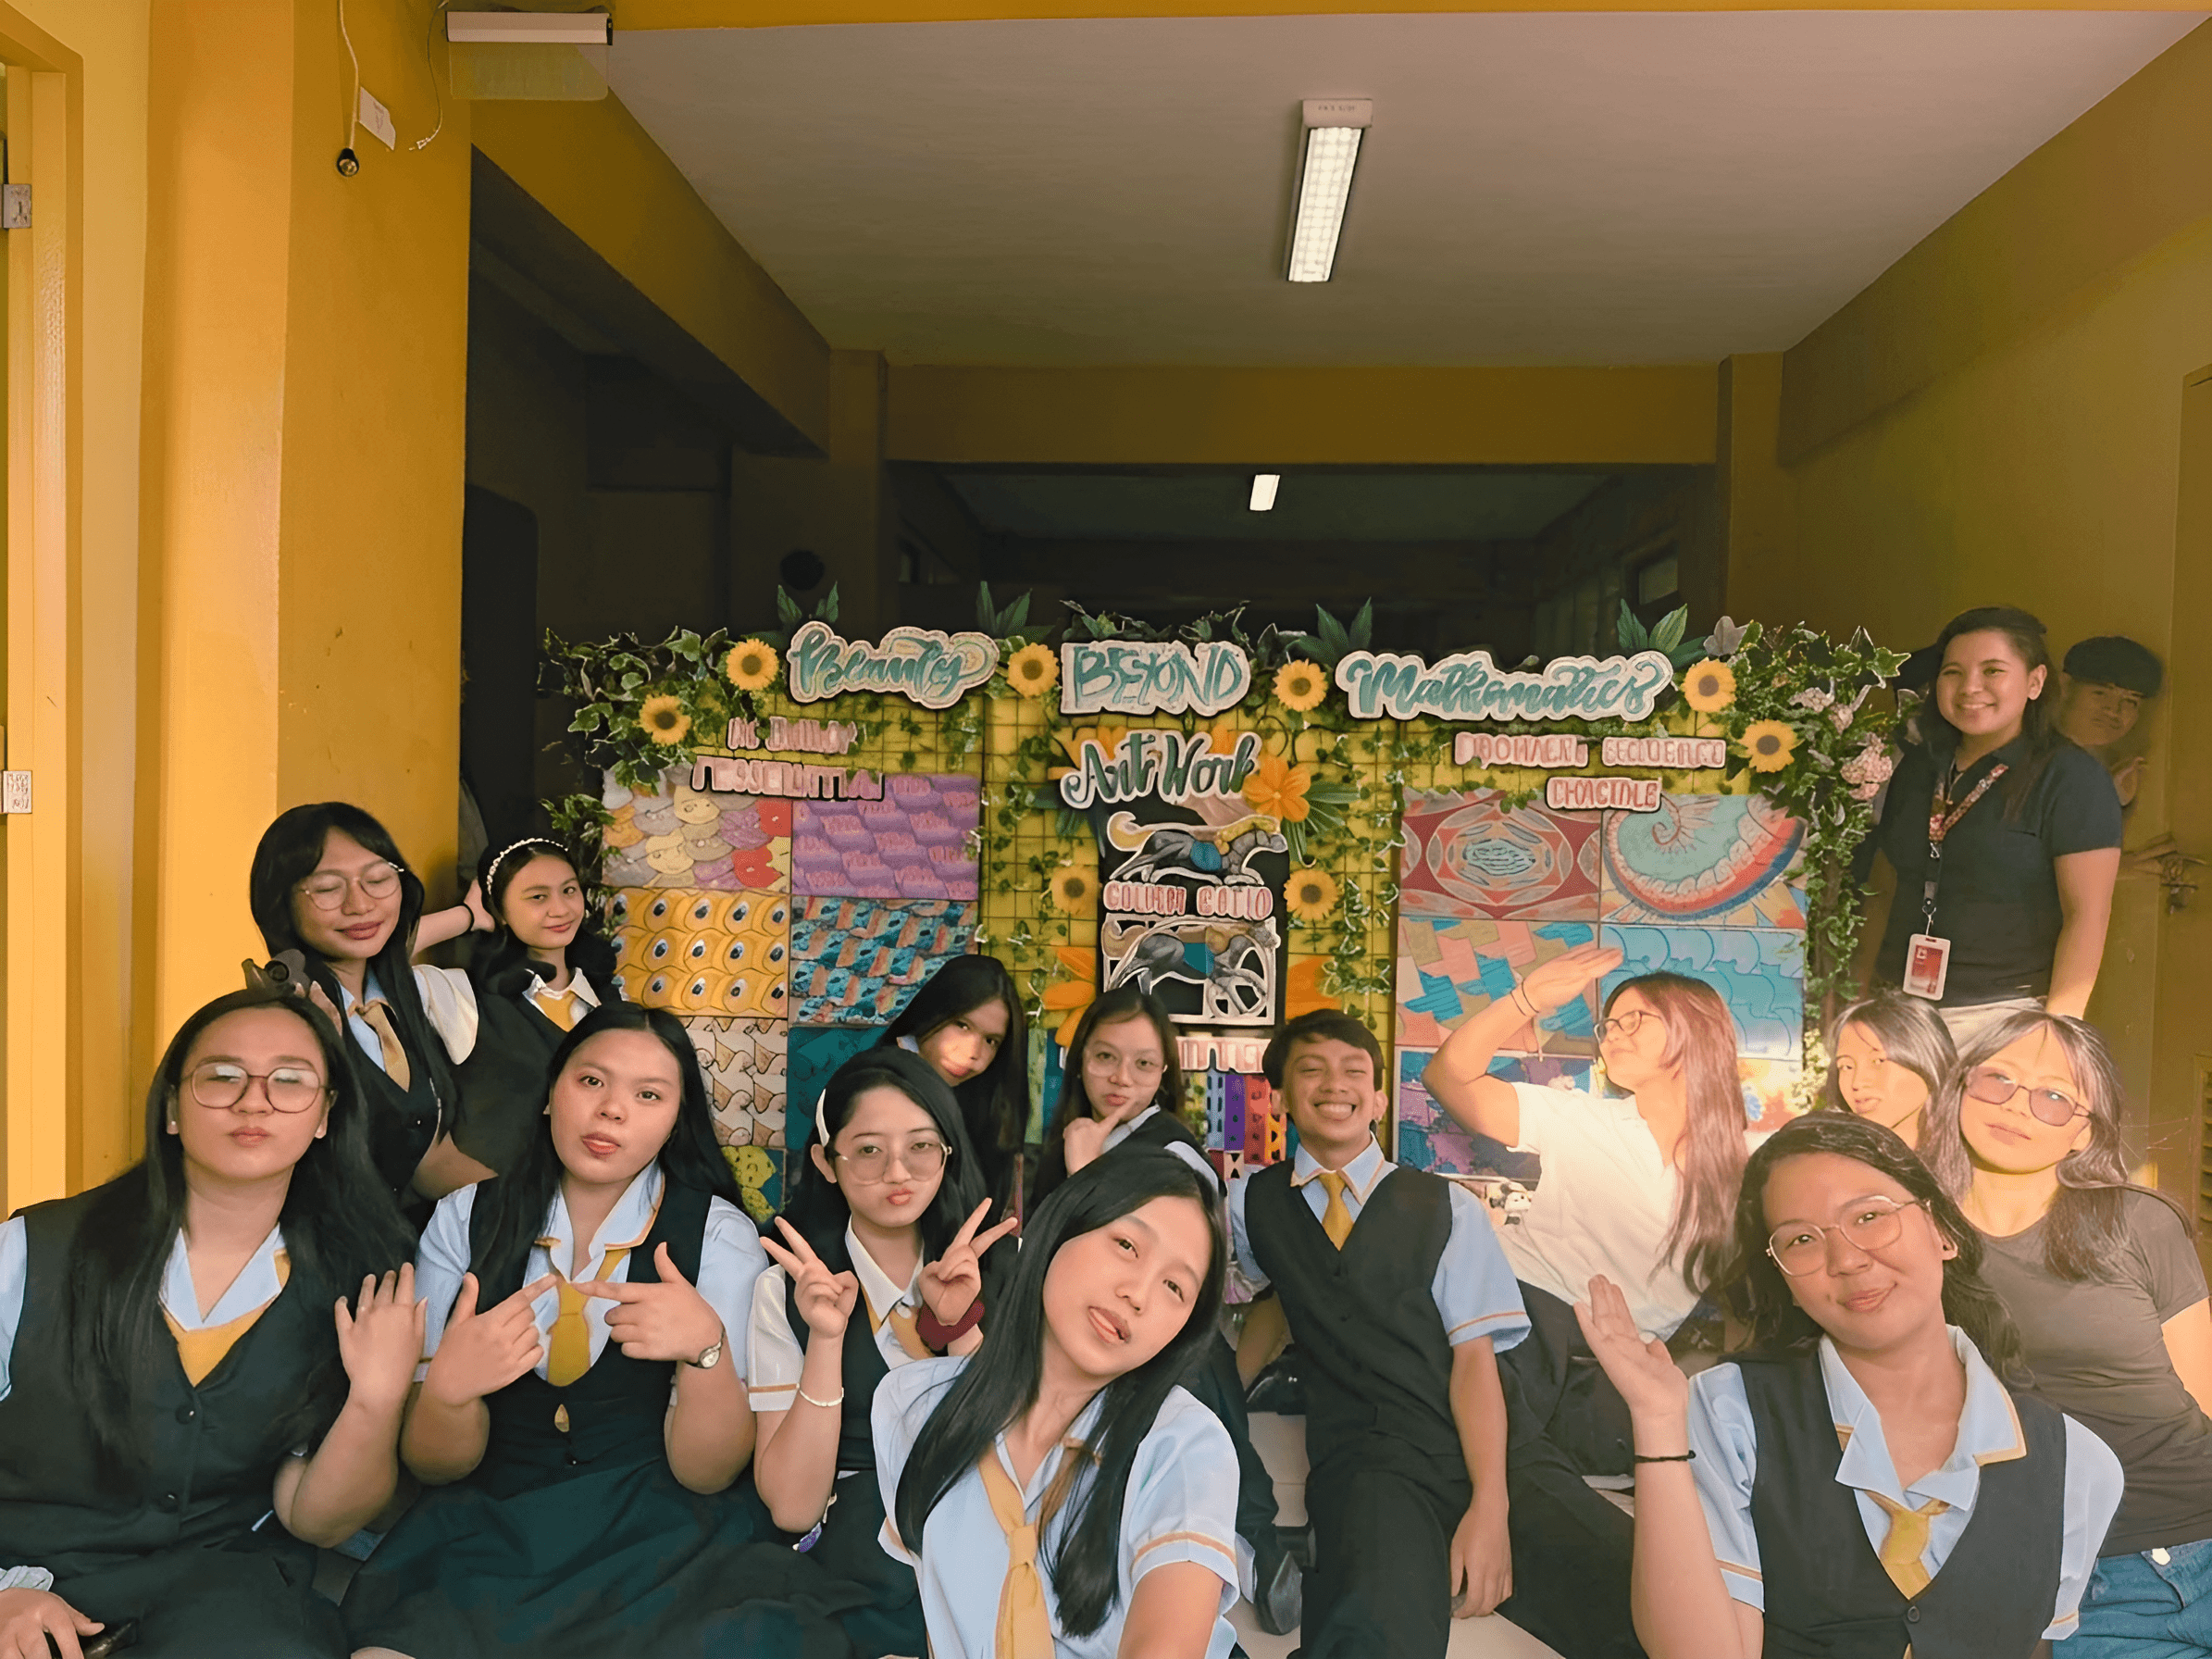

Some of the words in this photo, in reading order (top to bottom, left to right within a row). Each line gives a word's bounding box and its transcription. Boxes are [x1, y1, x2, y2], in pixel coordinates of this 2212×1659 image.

[1073, 644, 1243, 708] BEYOND
[1064, 732, 1156, 804] Art
[1162, 734, 1256, 797] Work
